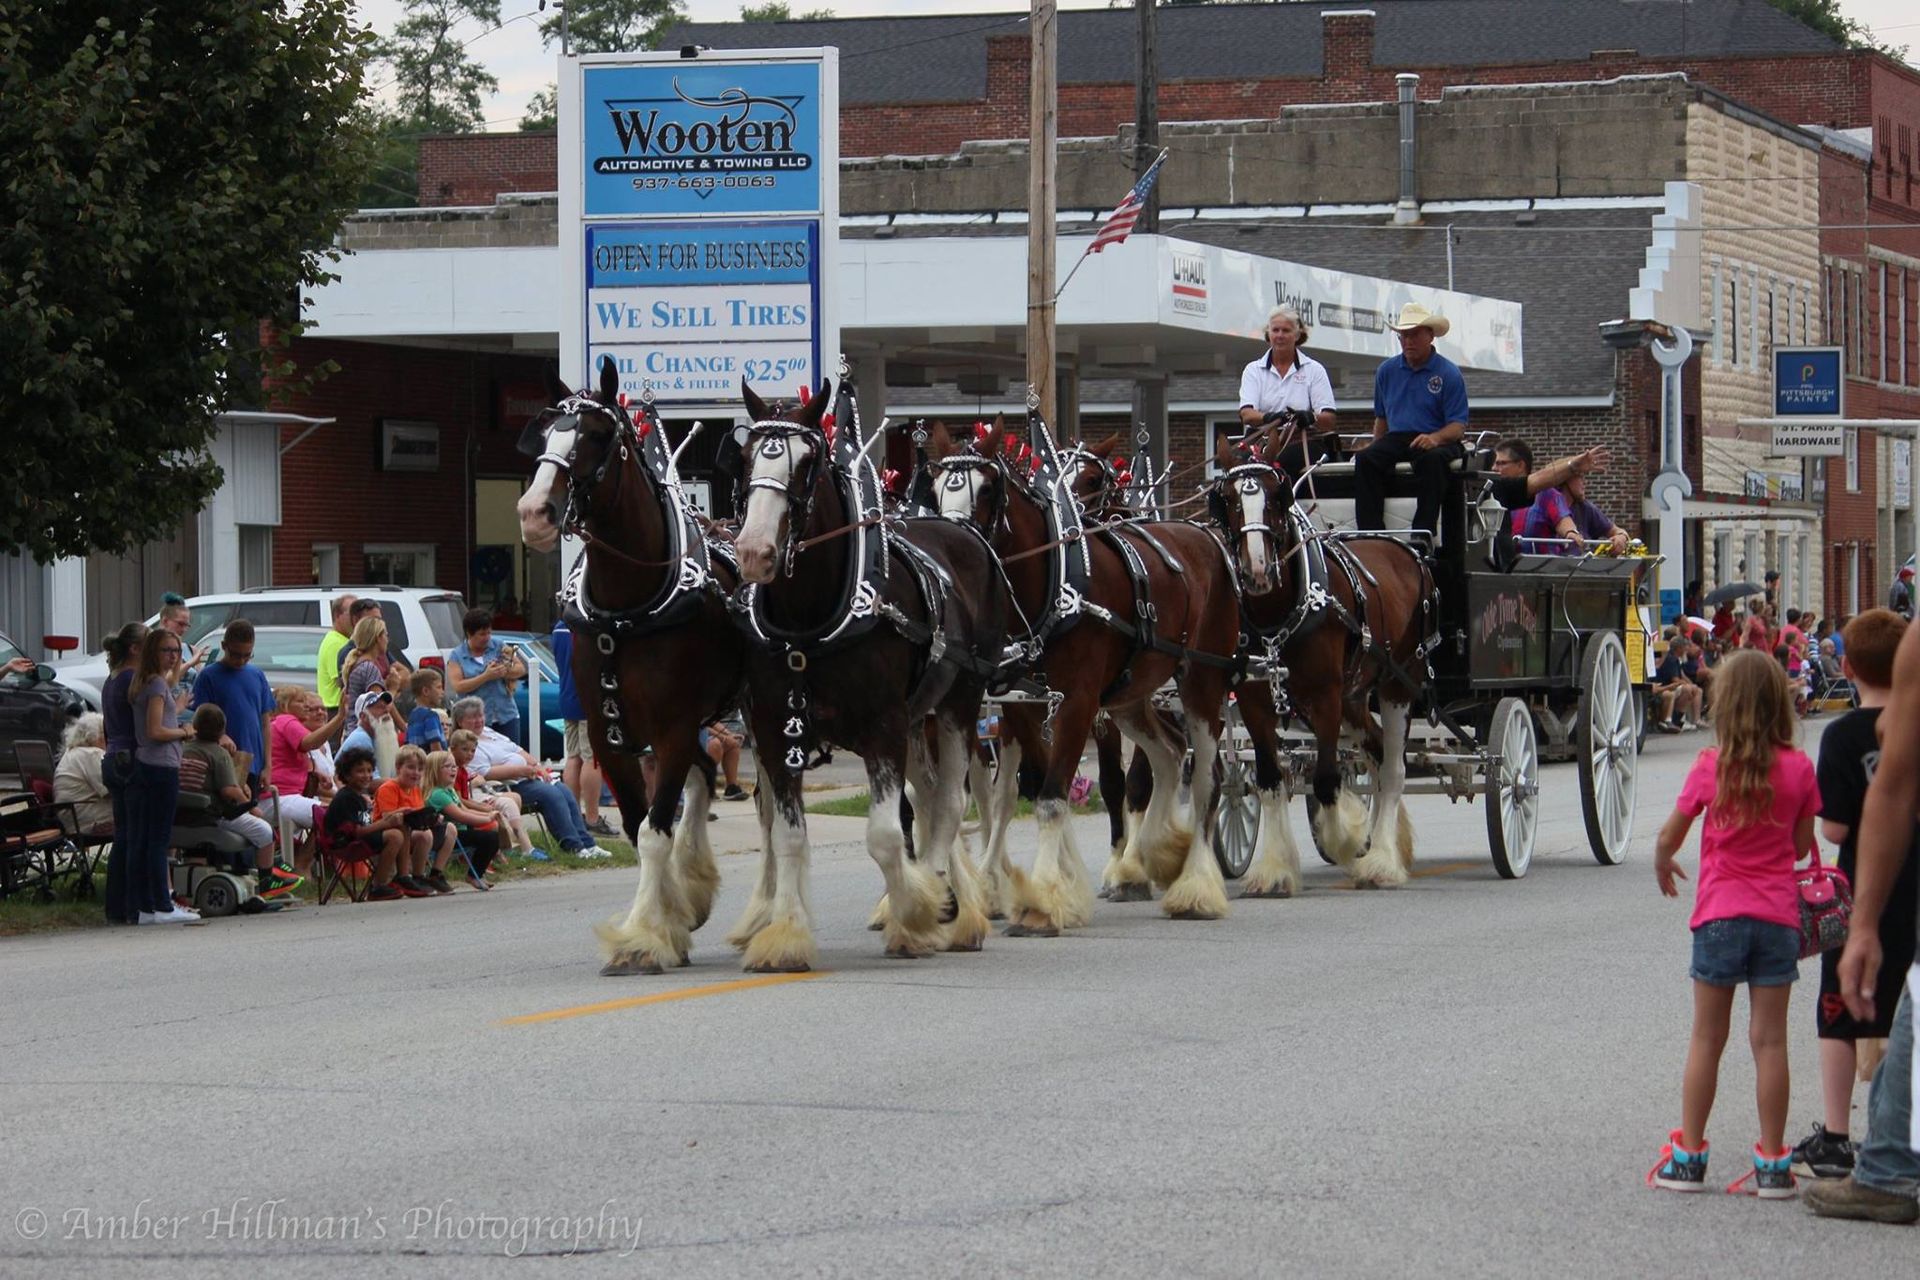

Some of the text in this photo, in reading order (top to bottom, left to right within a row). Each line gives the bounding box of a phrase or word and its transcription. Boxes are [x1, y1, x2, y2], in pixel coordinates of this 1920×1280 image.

[609, 96, 797, 155] Wooten
[599, 156, 807, 171] AUTOMOTIVE & TOWING LLC
[632, 175, 777, 190] 937-663-0063
[596, 240, 807, 271] OPEN FOR BUSINESS
[595, 299, 807, 329] WE SELL TIRES
[646, 351, 736, 373] CHANGE
[673, 377, 685, 390] &
[689, 380, 730, 390] FILTER
[1775, 437, 1841, 446] HARDWARE
